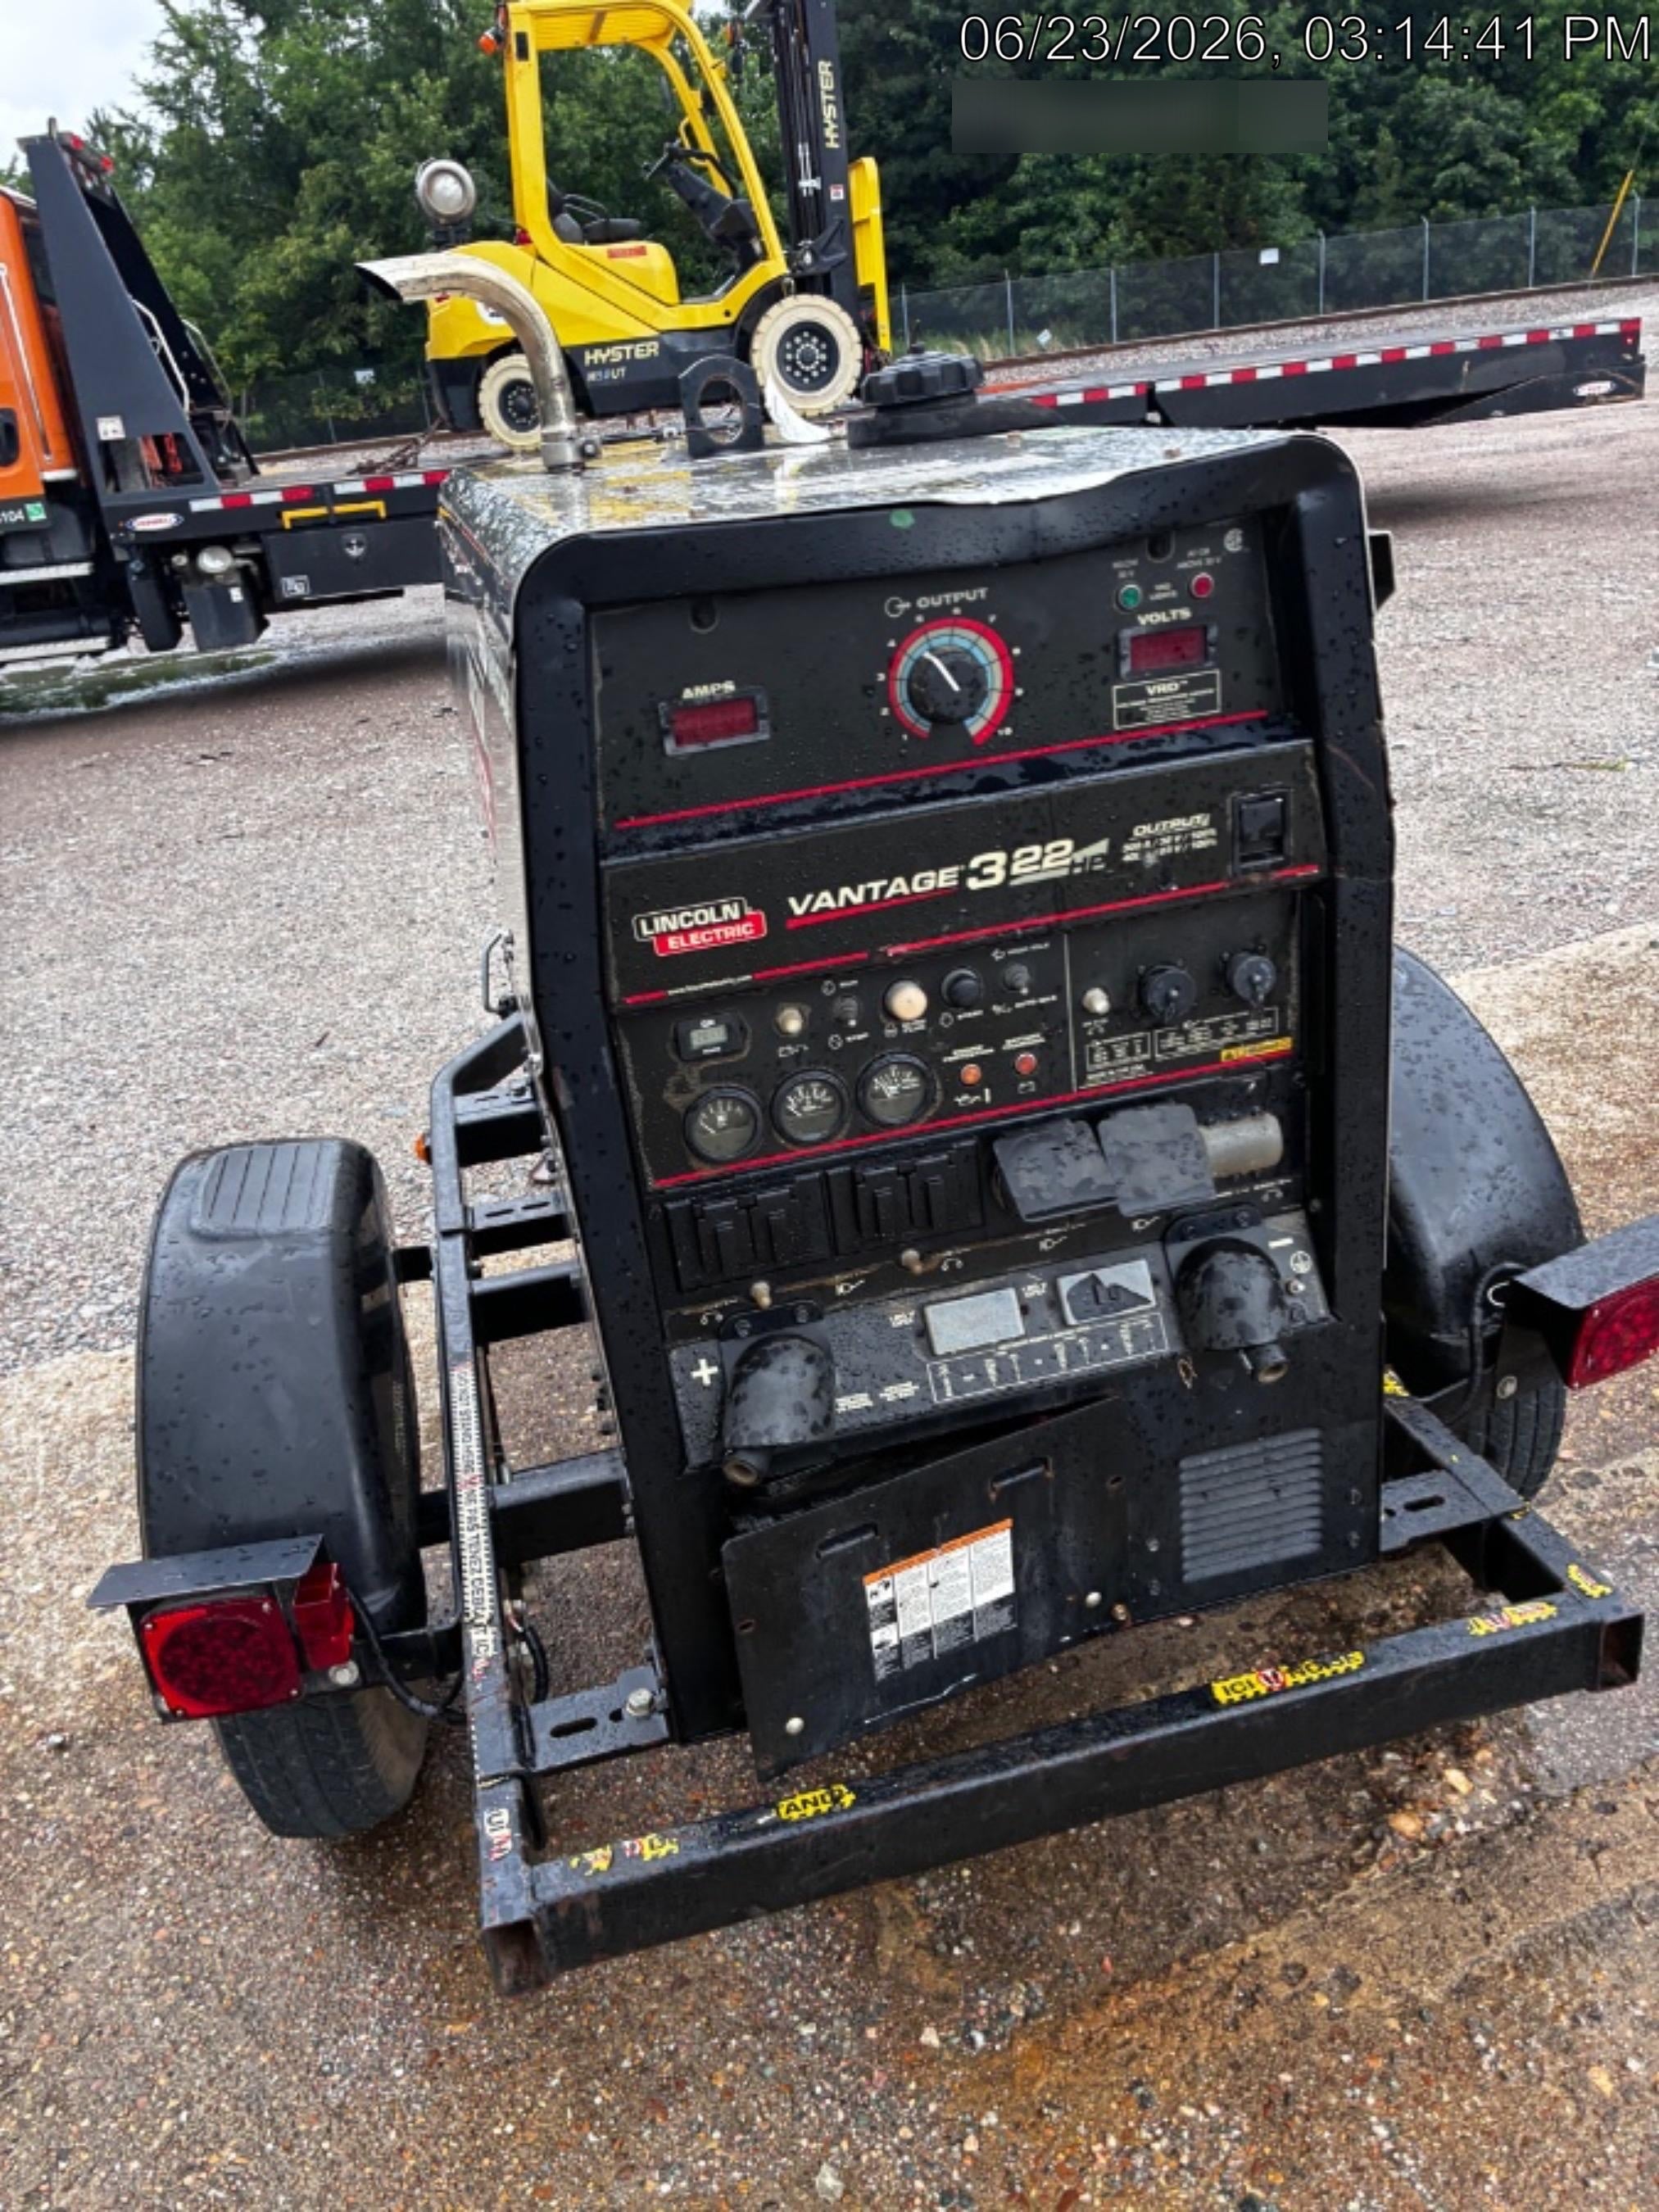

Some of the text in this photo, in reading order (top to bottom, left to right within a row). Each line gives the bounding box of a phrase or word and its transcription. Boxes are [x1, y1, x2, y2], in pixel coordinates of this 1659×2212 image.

[818, 60, 841, 148] HYSTER
[584, 342, 660, 366] HYSTER
[916, 587, 988, 609] OUTPUT
[1137, 607, 1192, 625] VOLTS
[682, 681, 735, 700] AMPS
[787, 866, 960, 916] VANTAGE
[966, 838, 1074, 891] 322
[640, 903, 738, 935] LINCOLN
[669, 922, 755, 950] ELECTRIC
